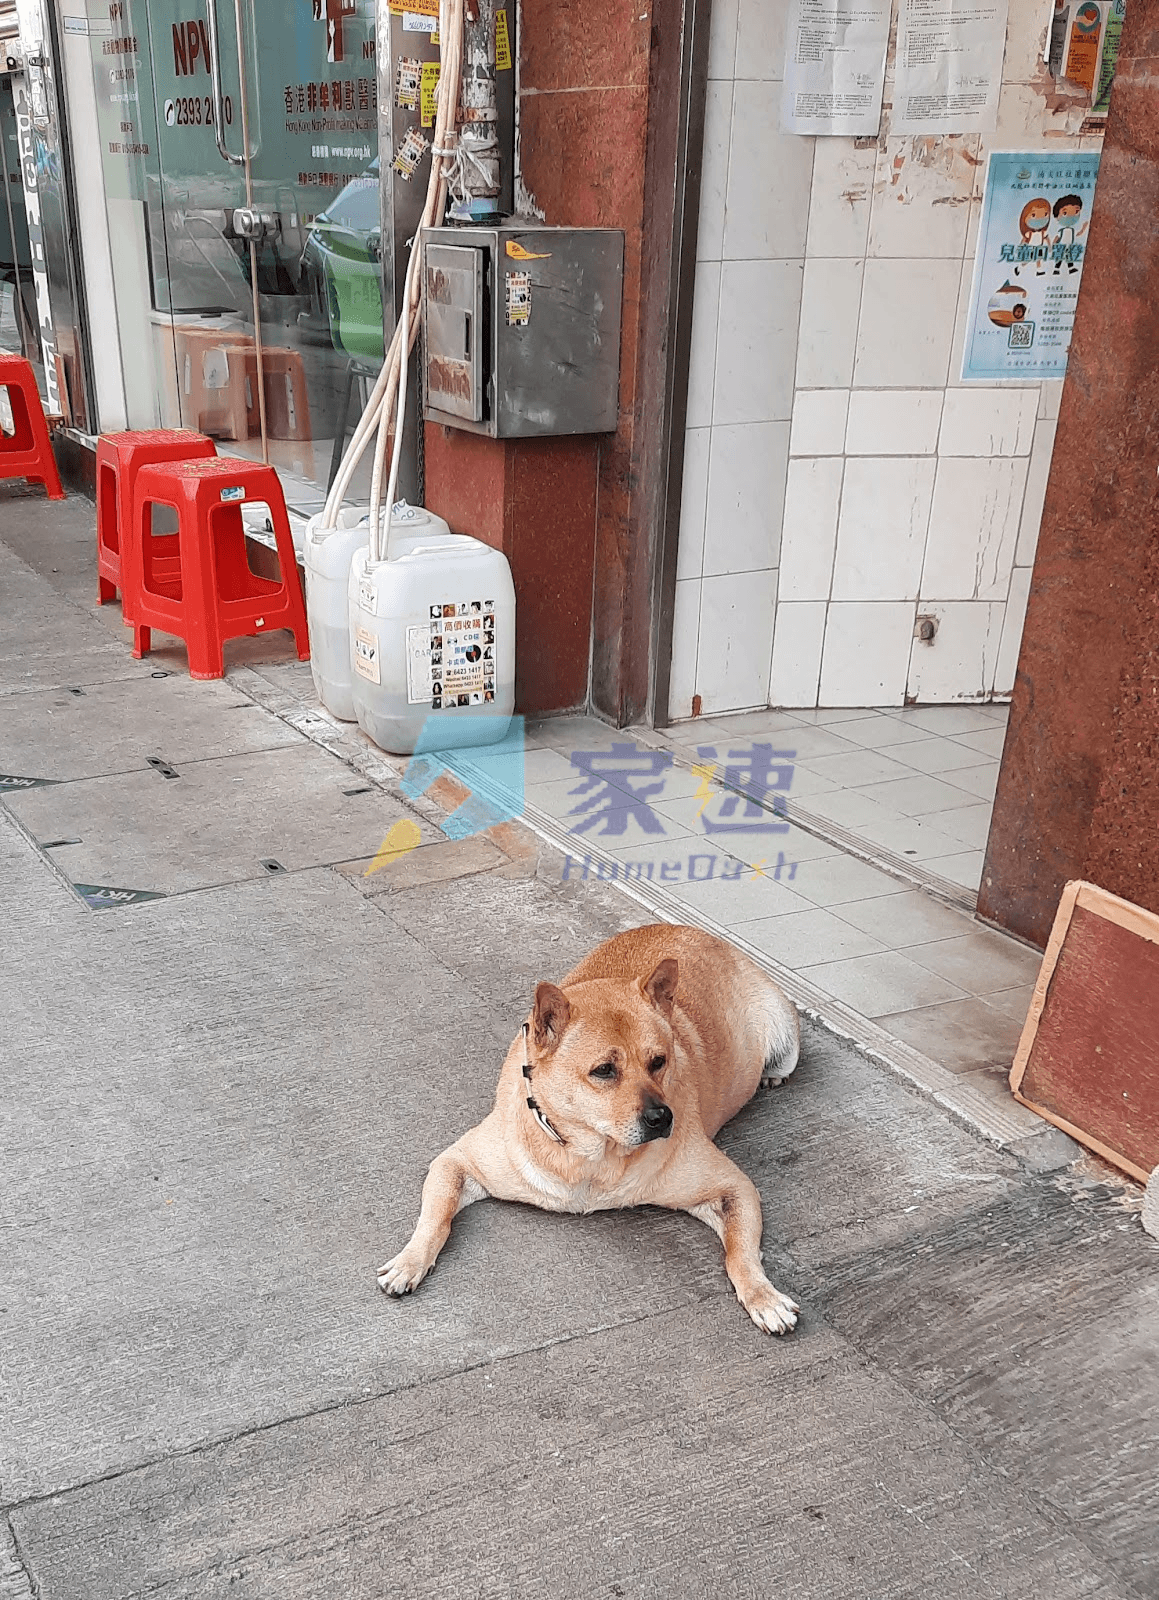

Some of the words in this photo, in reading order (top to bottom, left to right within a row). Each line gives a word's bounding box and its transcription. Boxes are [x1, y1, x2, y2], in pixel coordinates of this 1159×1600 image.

[109, 2, 123, 22] NPV
[363, 40, 376, 60] NP
[176, 97, 201, 125] 2393
[204, 95, 232, 125] 20
[468, 666, 482, 674] 1417
[85, 889, 137, 902] HKT
